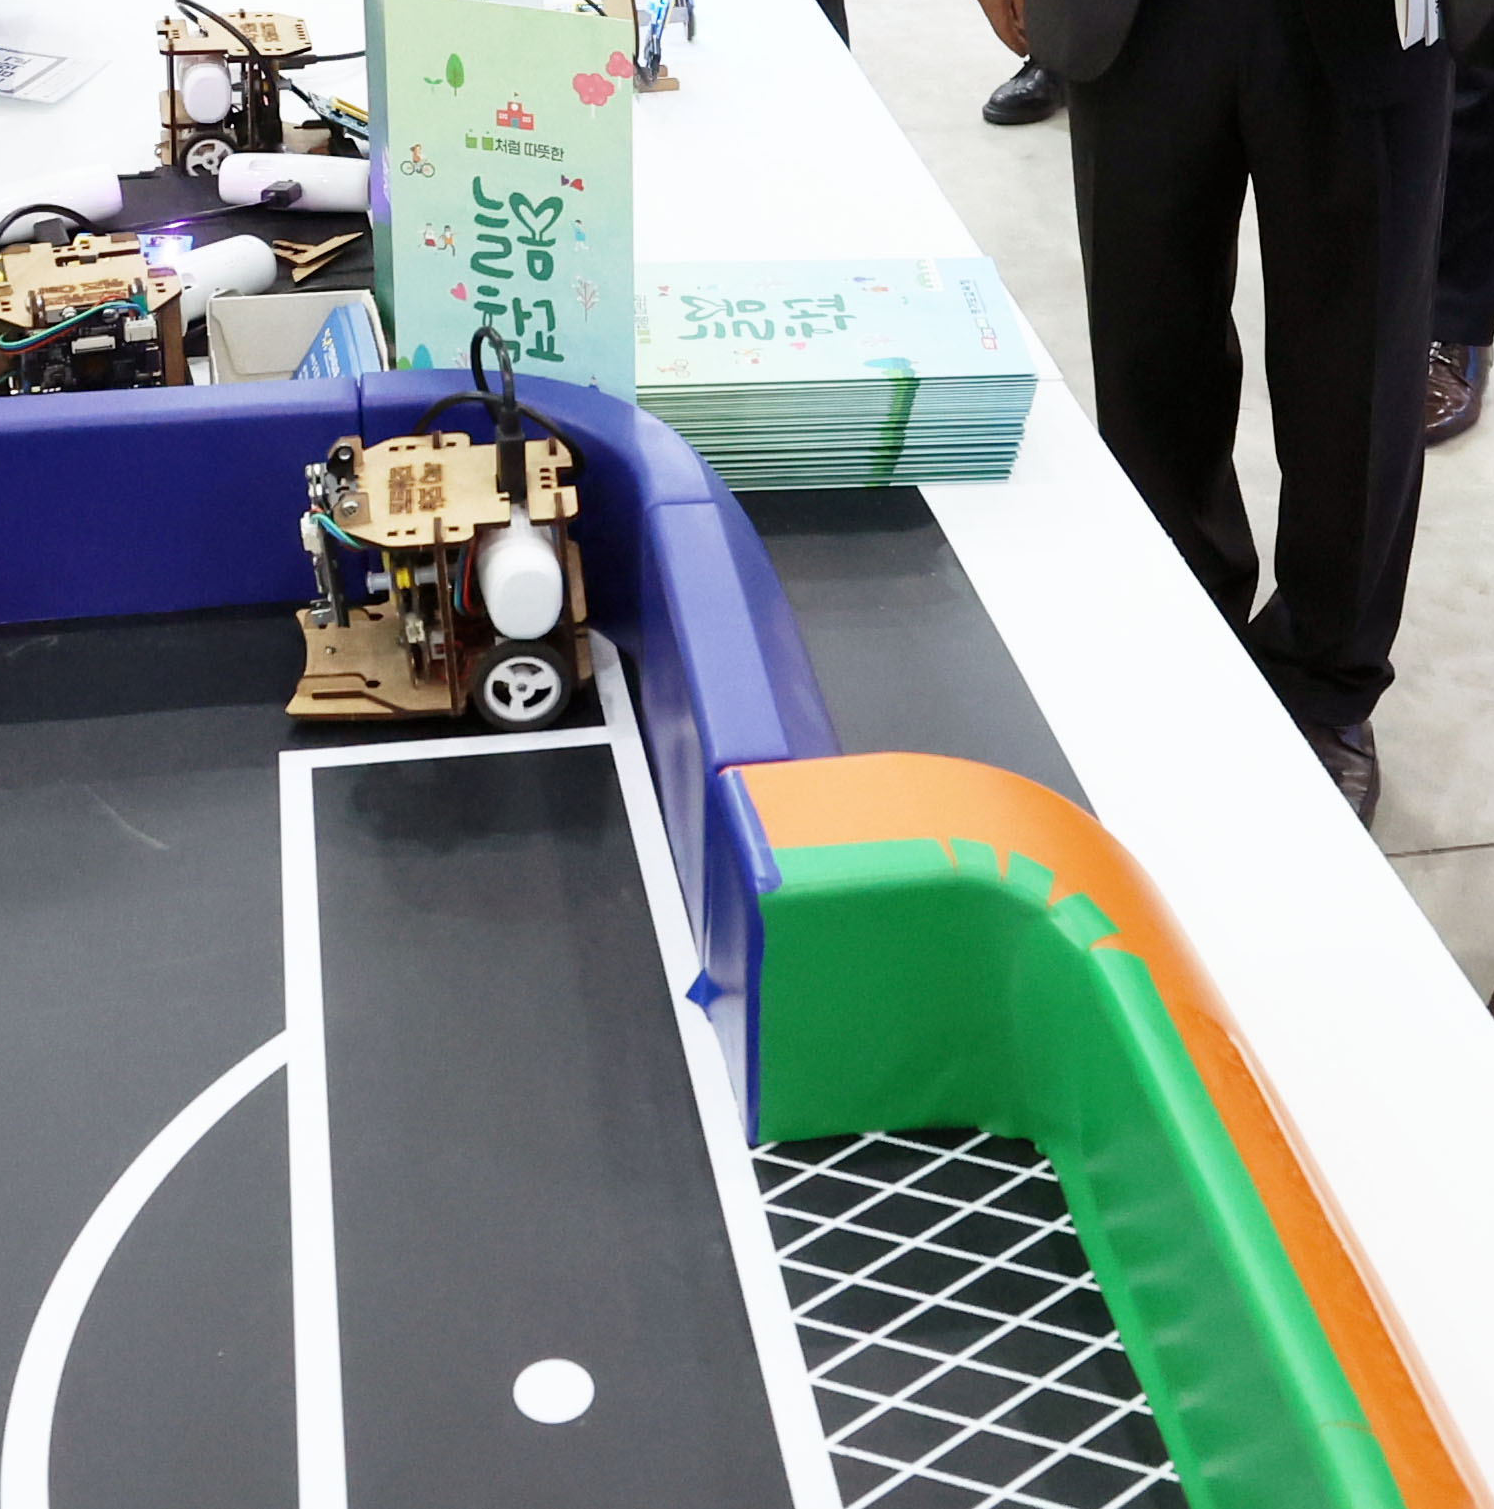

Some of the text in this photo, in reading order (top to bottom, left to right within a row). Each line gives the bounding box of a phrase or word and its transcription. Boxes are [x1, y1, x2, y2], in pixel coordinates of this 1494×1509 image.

[524, 142, 564, 162] 따뜻한
[471, 175, 564, 282] 늘봄
[473, 285, 565, 364] 학교
[677, 294, 775, 342] 늘봄
[782, 292, 857, 341] 학교
